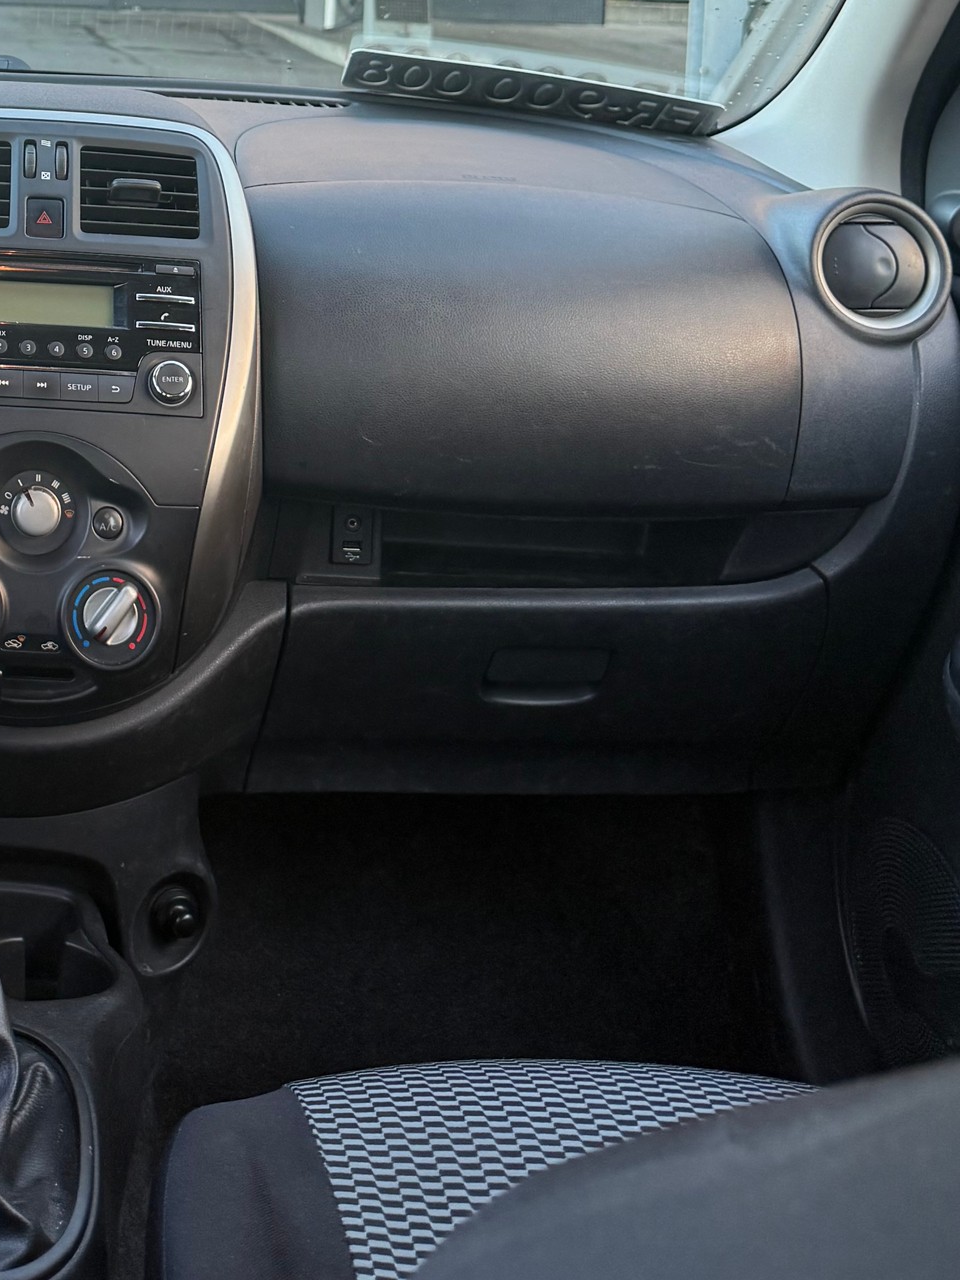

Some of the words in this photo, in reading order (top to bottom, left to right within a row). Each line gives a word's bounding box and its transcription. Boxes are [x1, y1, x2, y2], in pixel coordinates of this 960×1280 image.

[156, 285, 172, 293] AUX
[146, 338, 192, 349] TUNE/MENU
[162, 375, 184, 384] ENTER
[67, 383, 92, 392] SETUP
[99, 521, 117, 532] A/C
